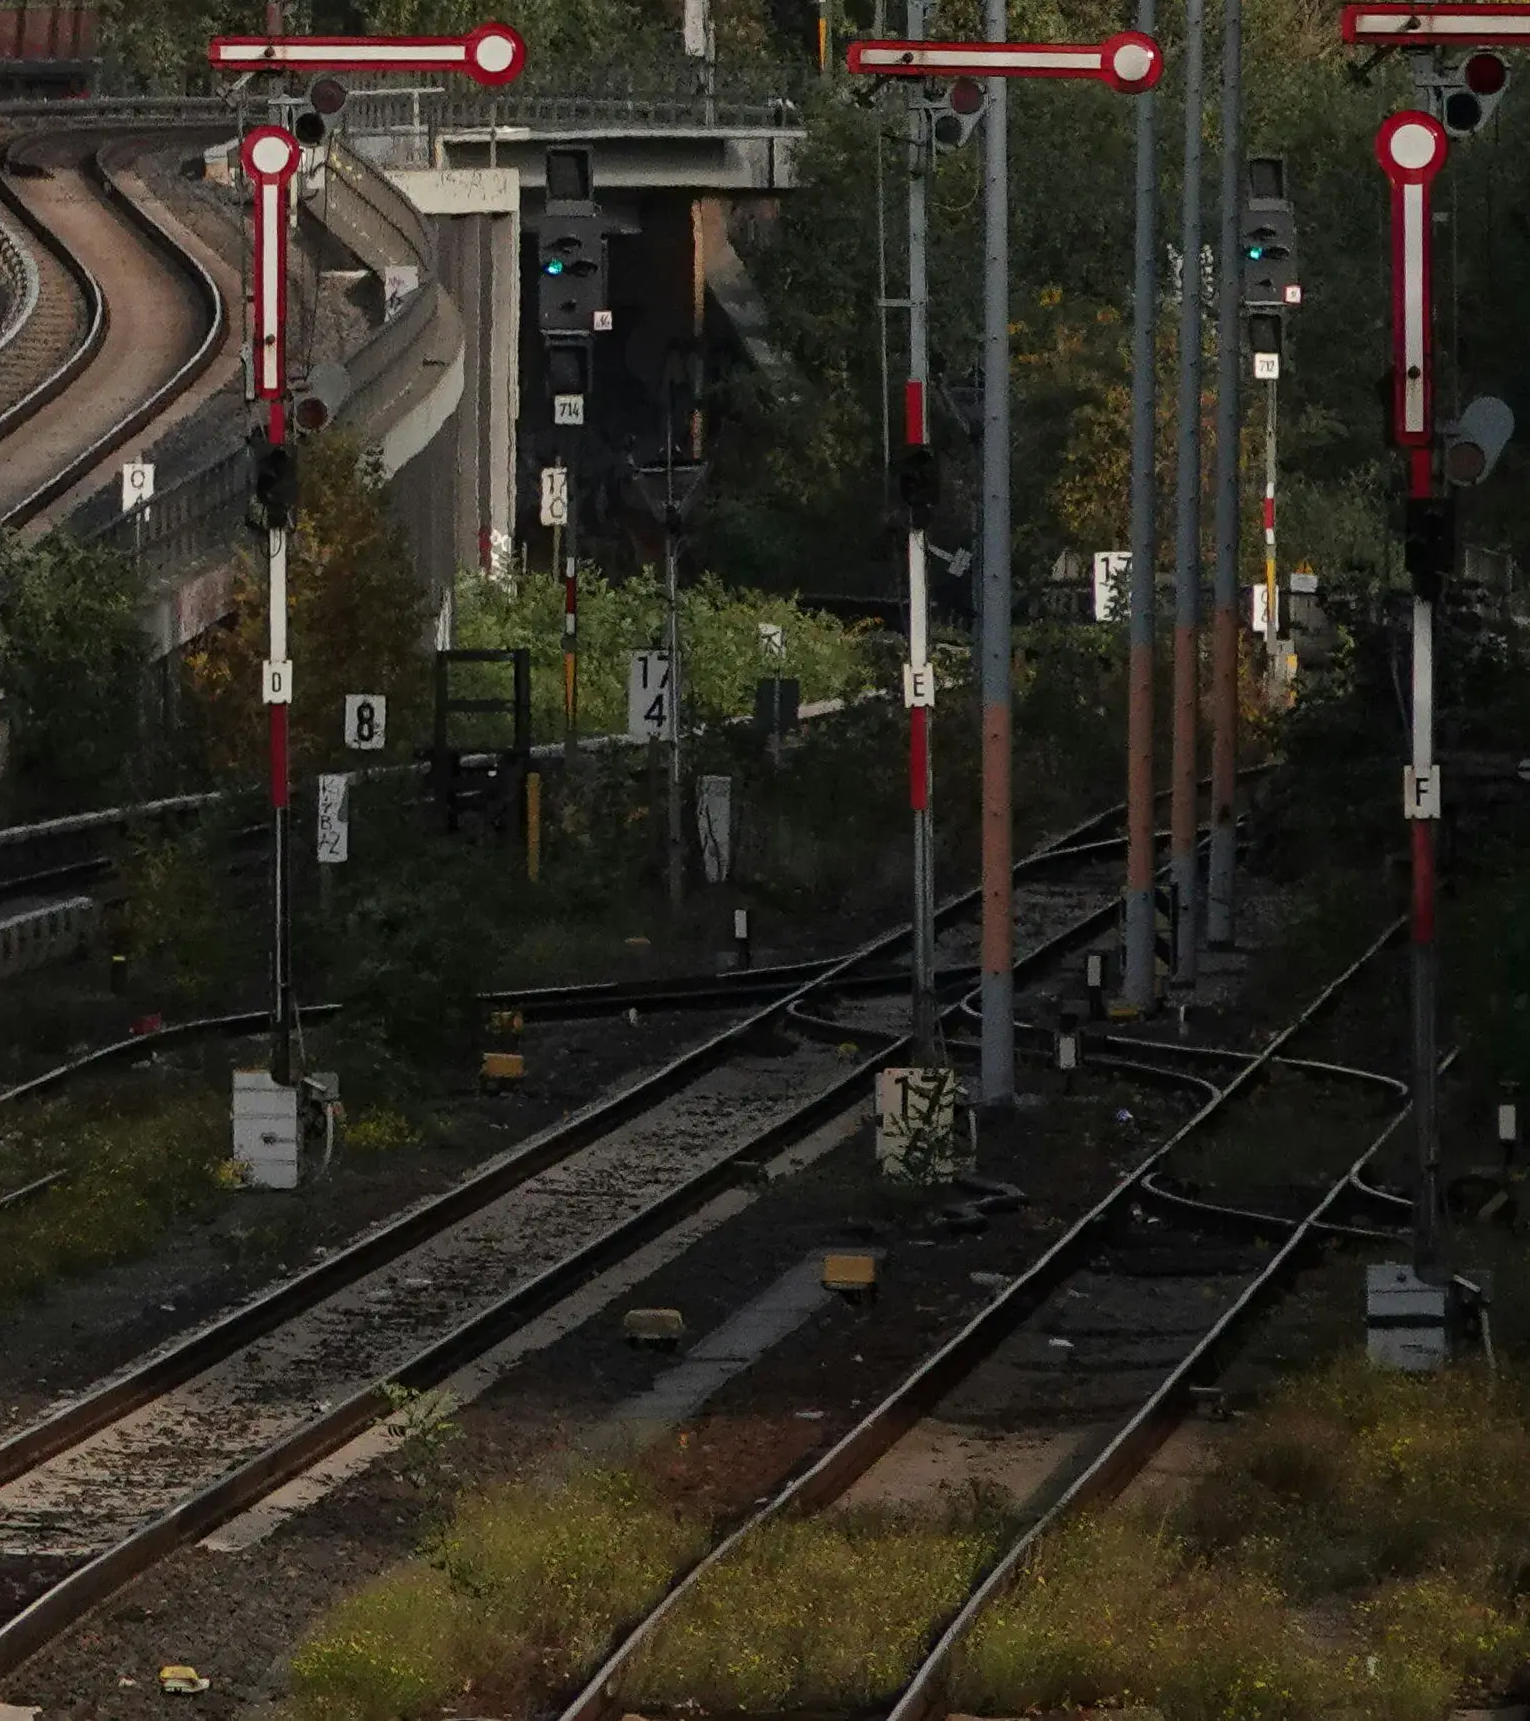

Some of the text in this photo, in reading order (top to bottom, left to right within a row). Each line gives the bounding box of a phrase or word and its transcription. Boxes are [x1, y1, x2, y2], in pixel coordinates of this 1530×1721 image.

[559, 403, 579, 417] 714
[638, 656, 673, 690] 17
[913, 673, 924, 697] E
[356, 701, 375, 742] 8
[644, 694, 667, 728] 4
[1415, 777, 1428, 807] F
[895, 1076, 948, 1125] 17
